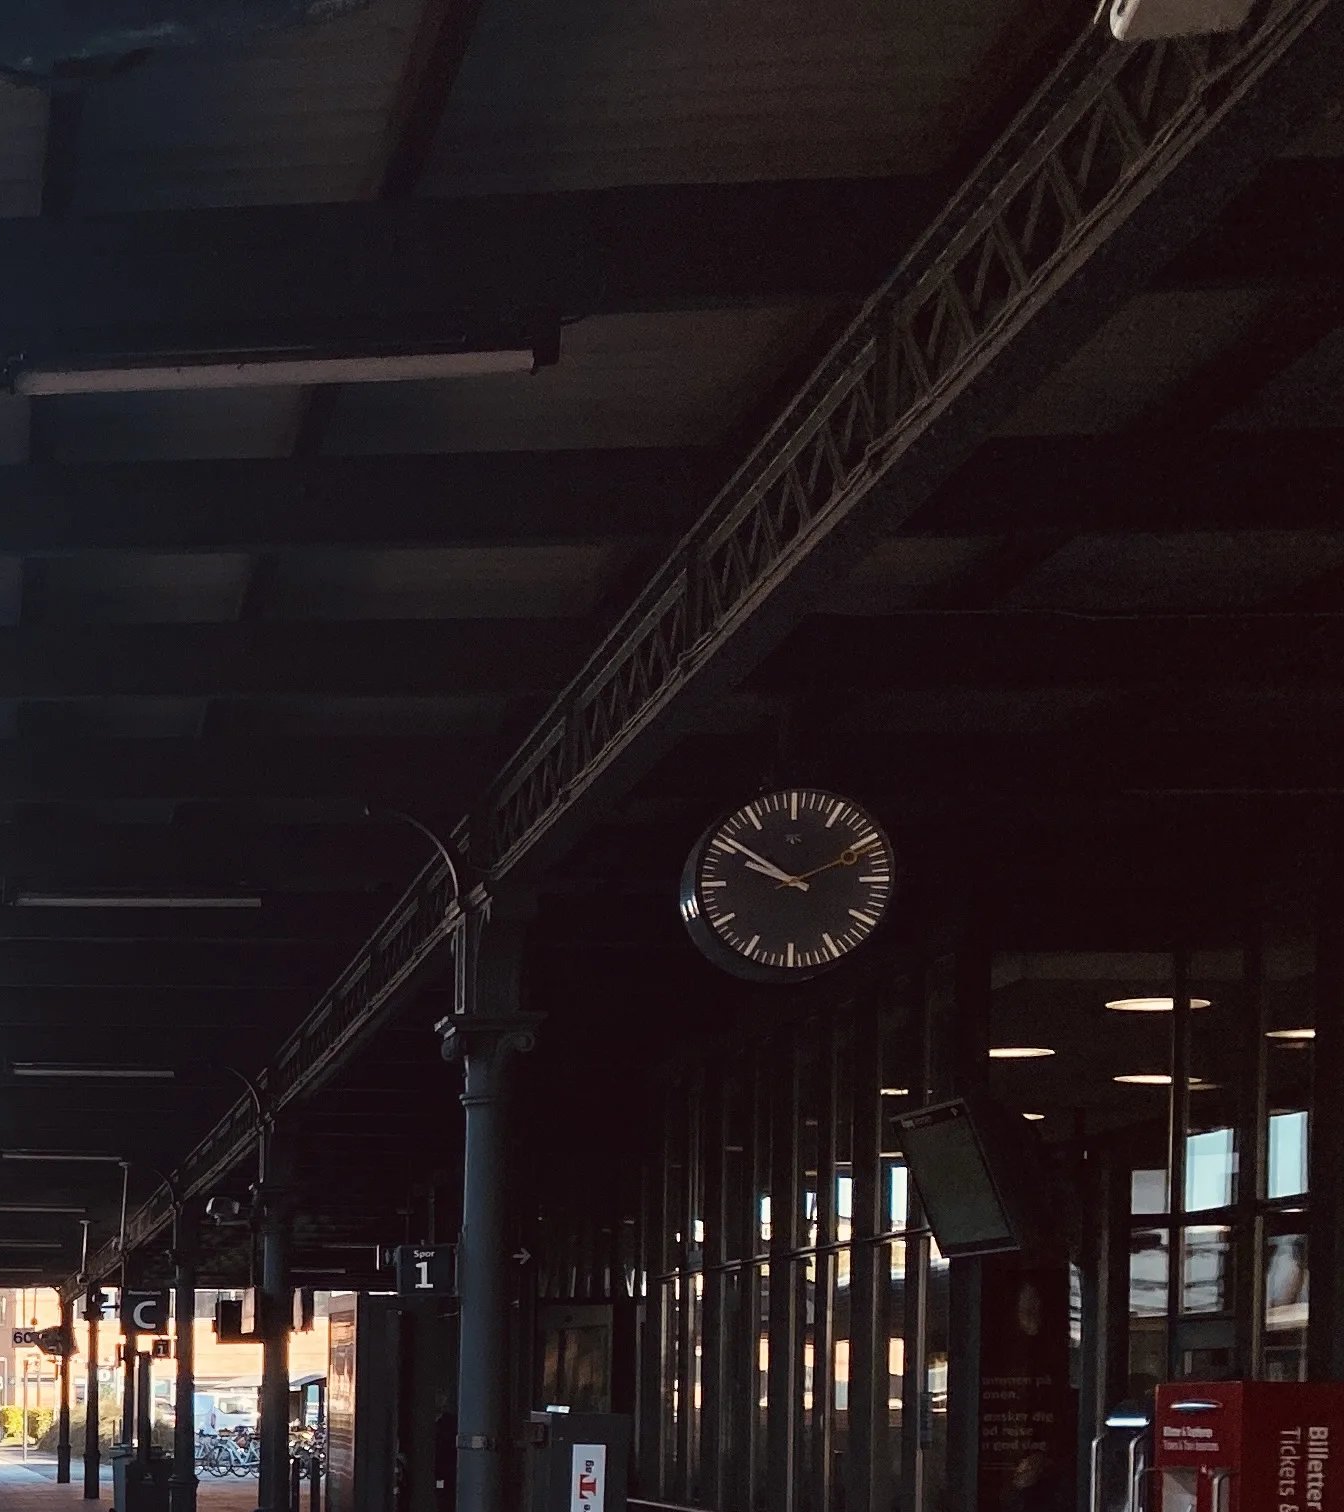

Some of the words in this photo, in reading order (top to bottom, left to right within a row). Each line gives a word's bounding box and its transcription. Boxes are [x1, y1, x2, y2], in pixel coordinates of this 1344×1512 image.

[413, 1249, 435, 1259] Spor
[414, 1261, 434, 1289] 1
[132, 1300, 157, 1329] C
[1278, 1426, 1301, 1496] Tickets
[1306, 1426, 1329, 1511] Billetter
[579, 1460, 597, 1500] Tag
